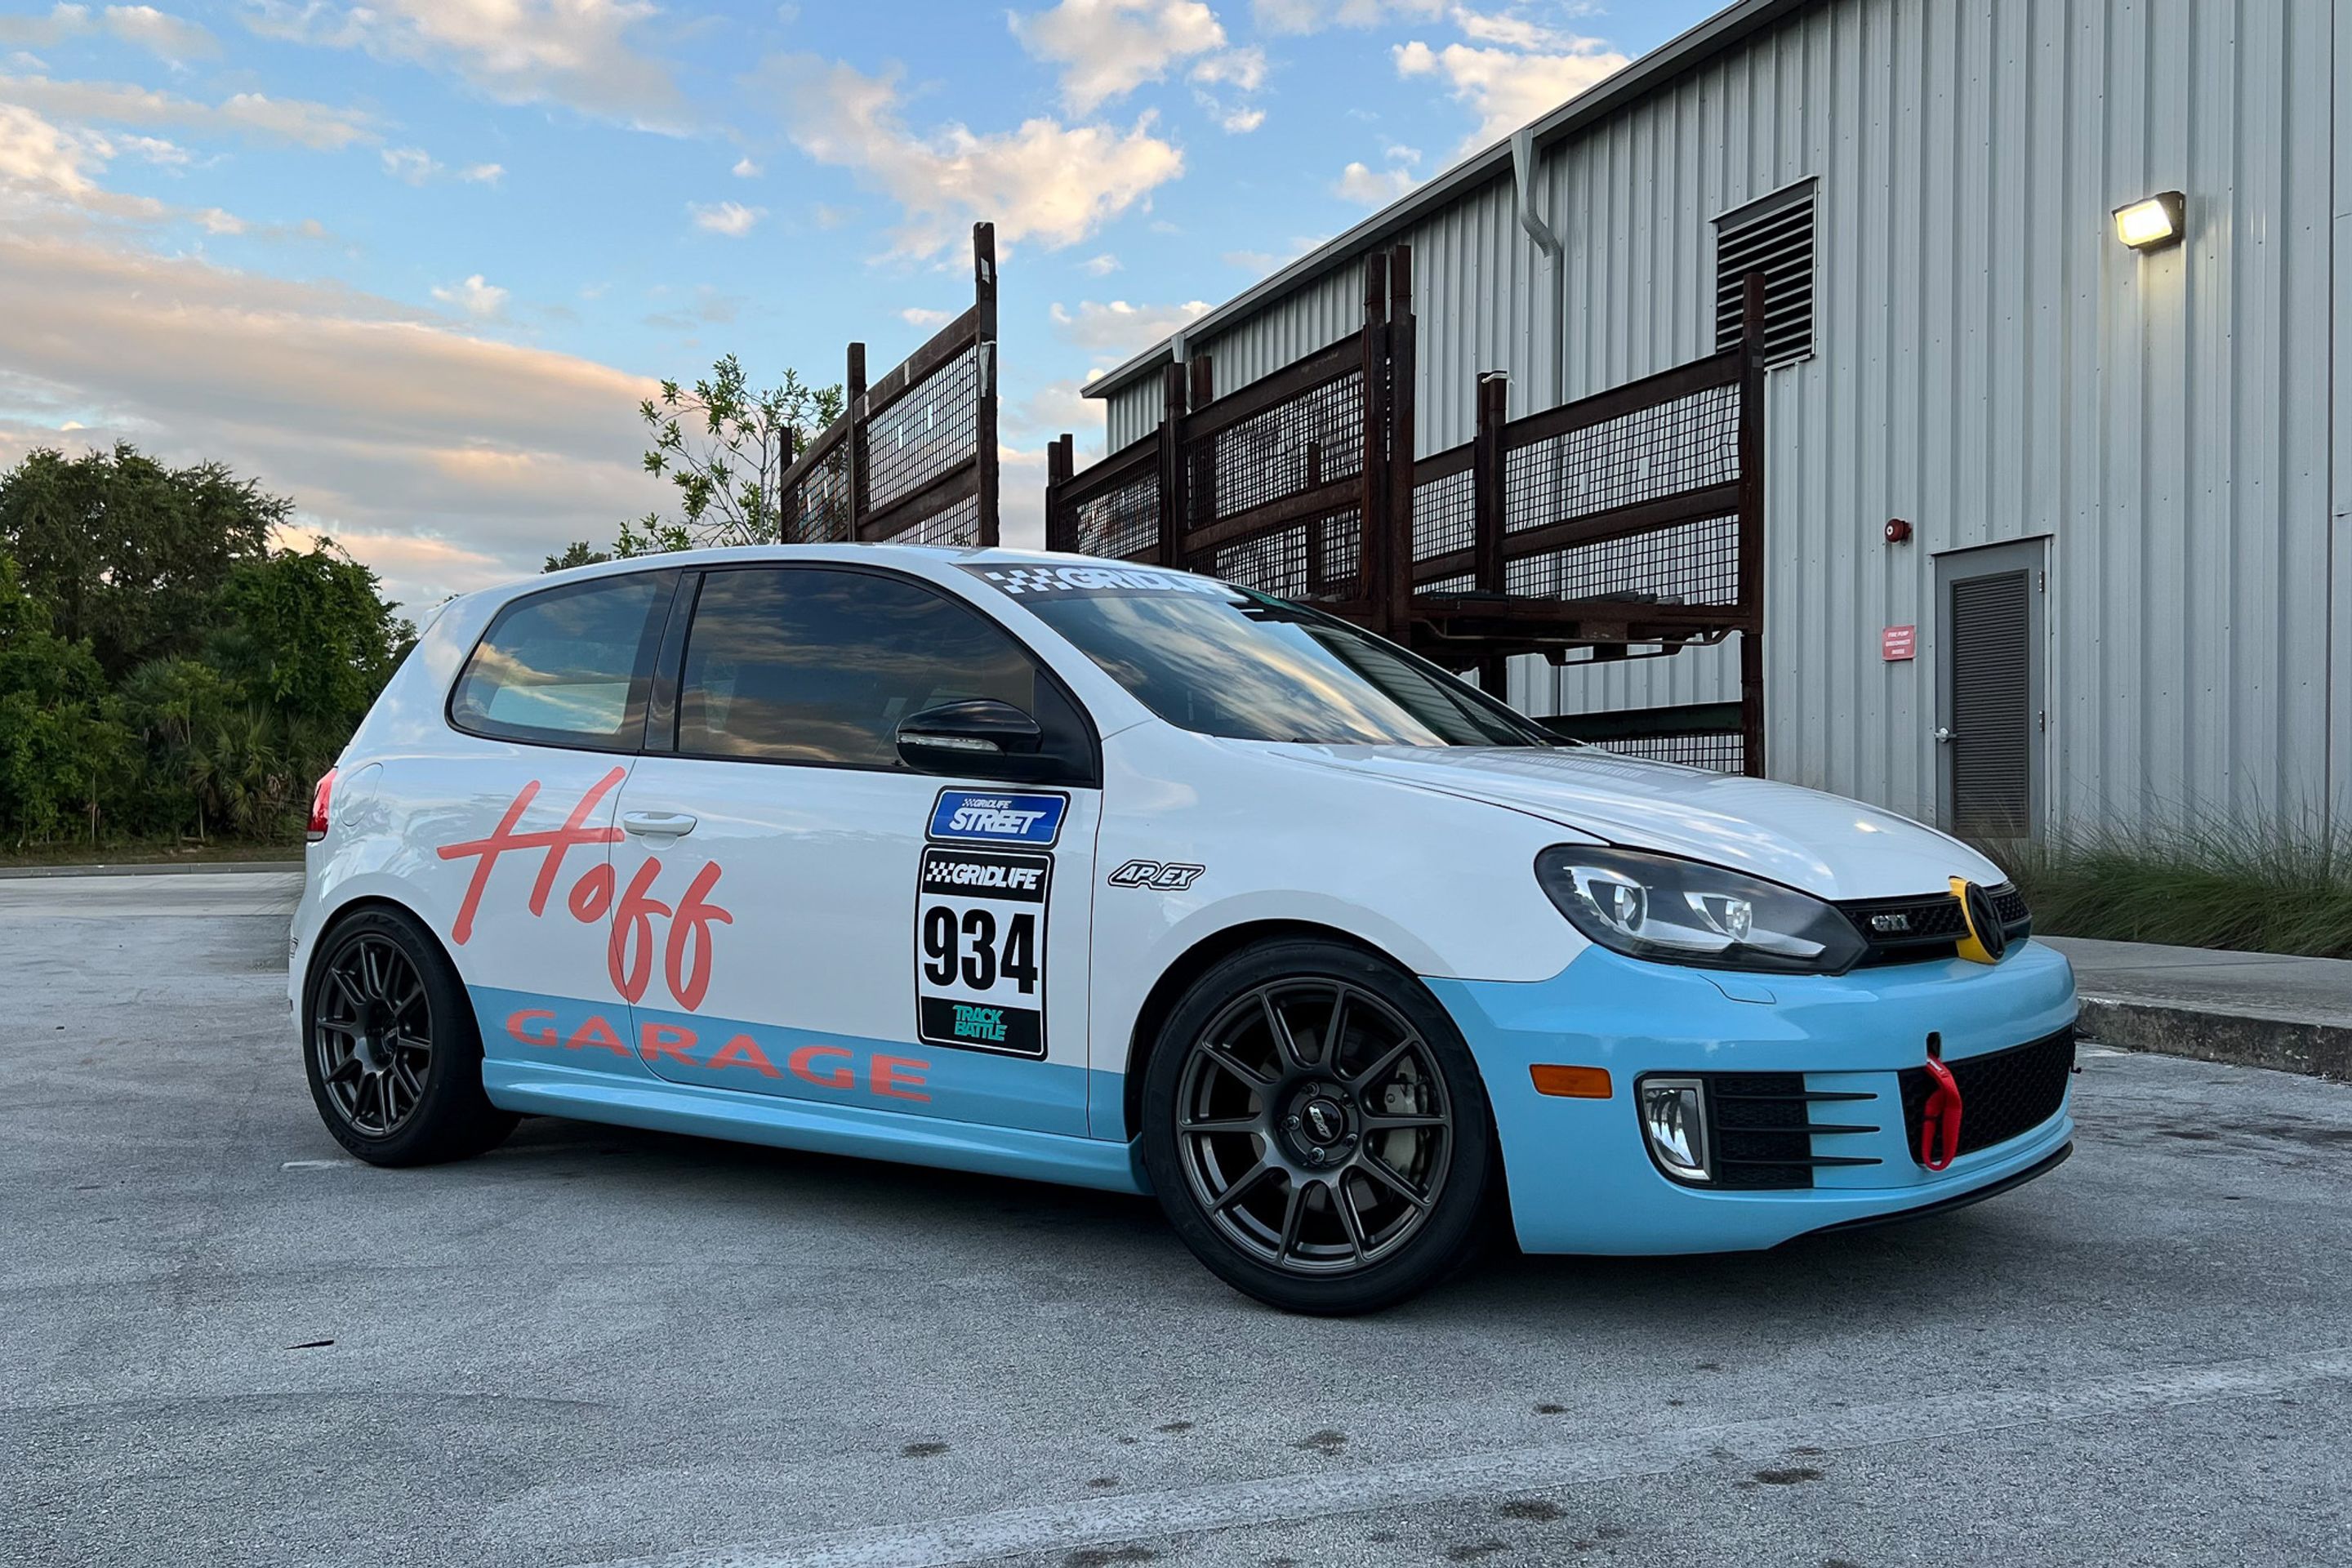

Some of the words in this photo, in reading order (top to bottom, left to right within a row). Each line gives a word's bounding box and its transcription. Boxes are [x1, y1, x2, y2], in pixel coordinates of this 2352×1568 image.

[973, 800, 1012, 808] GRIDLIFE
[949, 808, 1046, 834] STREET
[436, 766, 733, 1013] Hoff
[951, 862, 1045, 891] GRIDLIFE
[1872, 915, 1911, 932] GTI
[924, 906, 1038, 994] 934
[952, 1004, 1004, 1023] TRACK
[954, 1022, 1007, 1041] BATTLE
[506, 1009, 932, 1103] GARAGE
